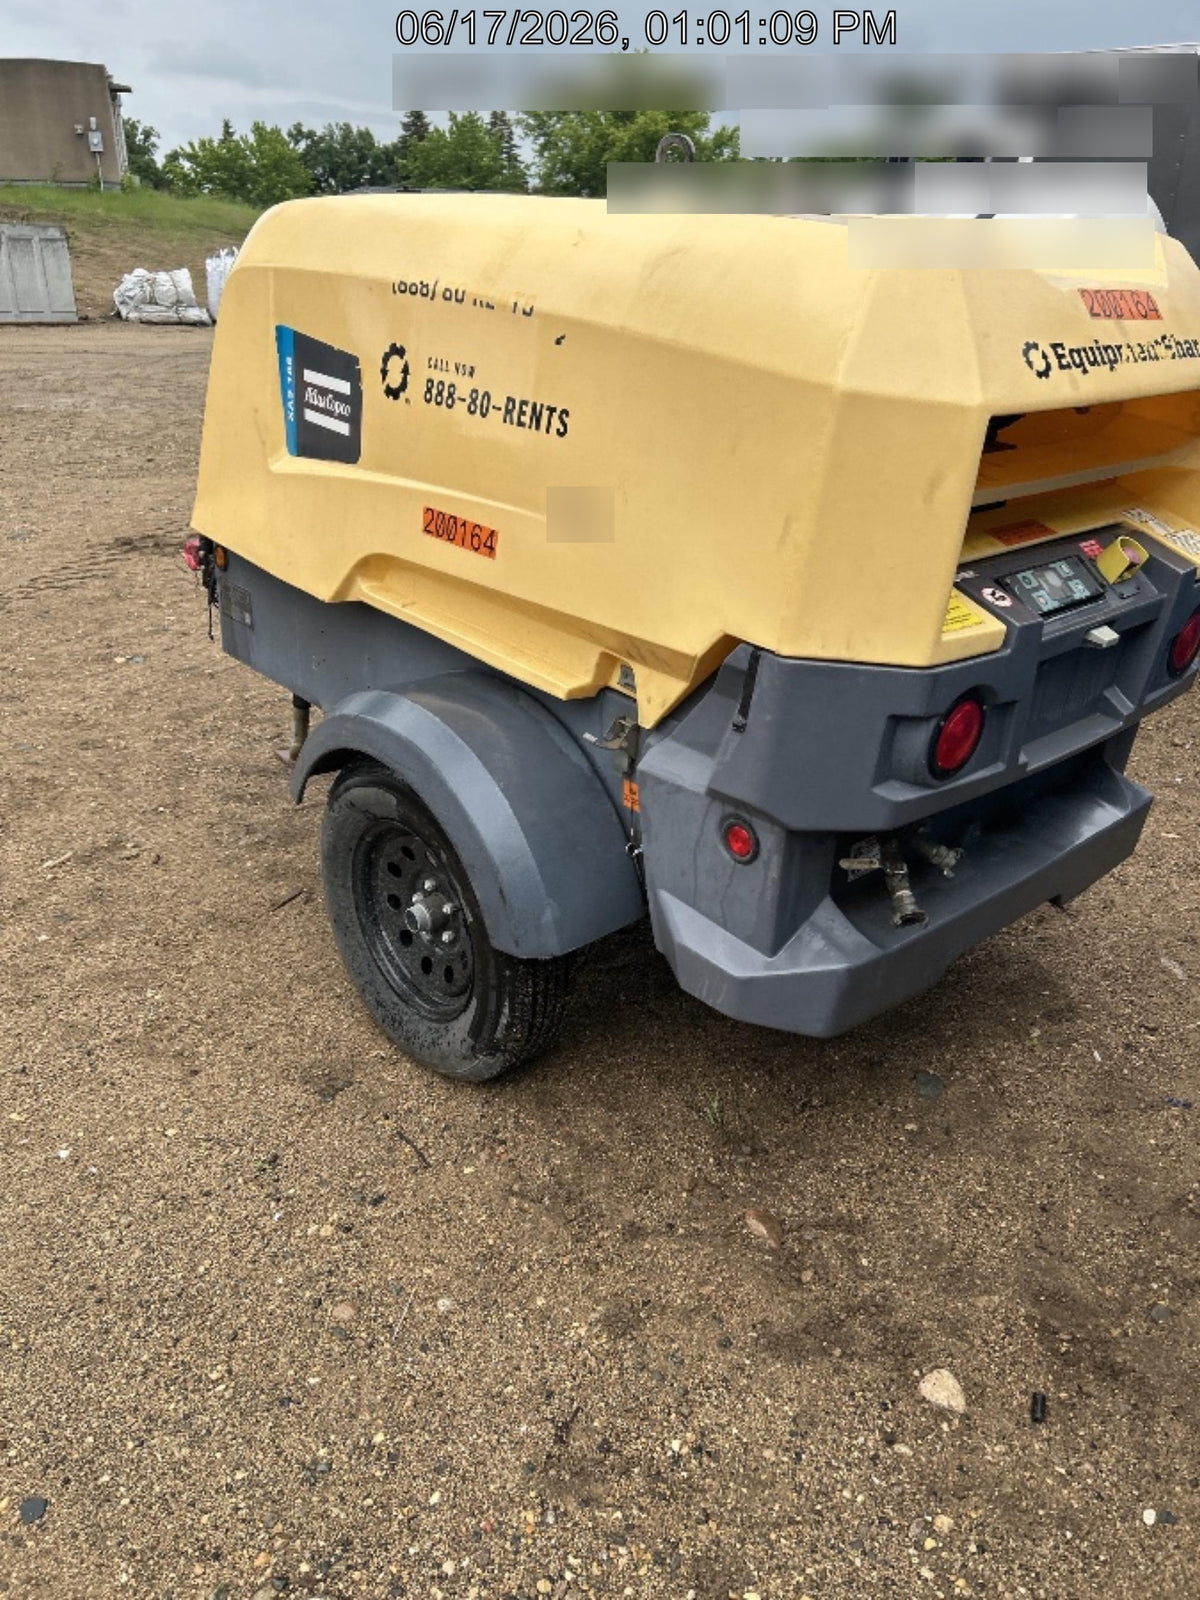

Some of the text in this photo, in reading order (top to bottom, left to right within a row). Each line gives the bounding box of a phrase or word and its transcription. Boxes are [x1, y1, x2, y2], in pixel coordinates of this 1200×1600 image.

[1080, 289, 1161, 319] 200164
[423, 377, 570, 438] 888-80-RENTS
[424, 508, 497, 554] 200164
